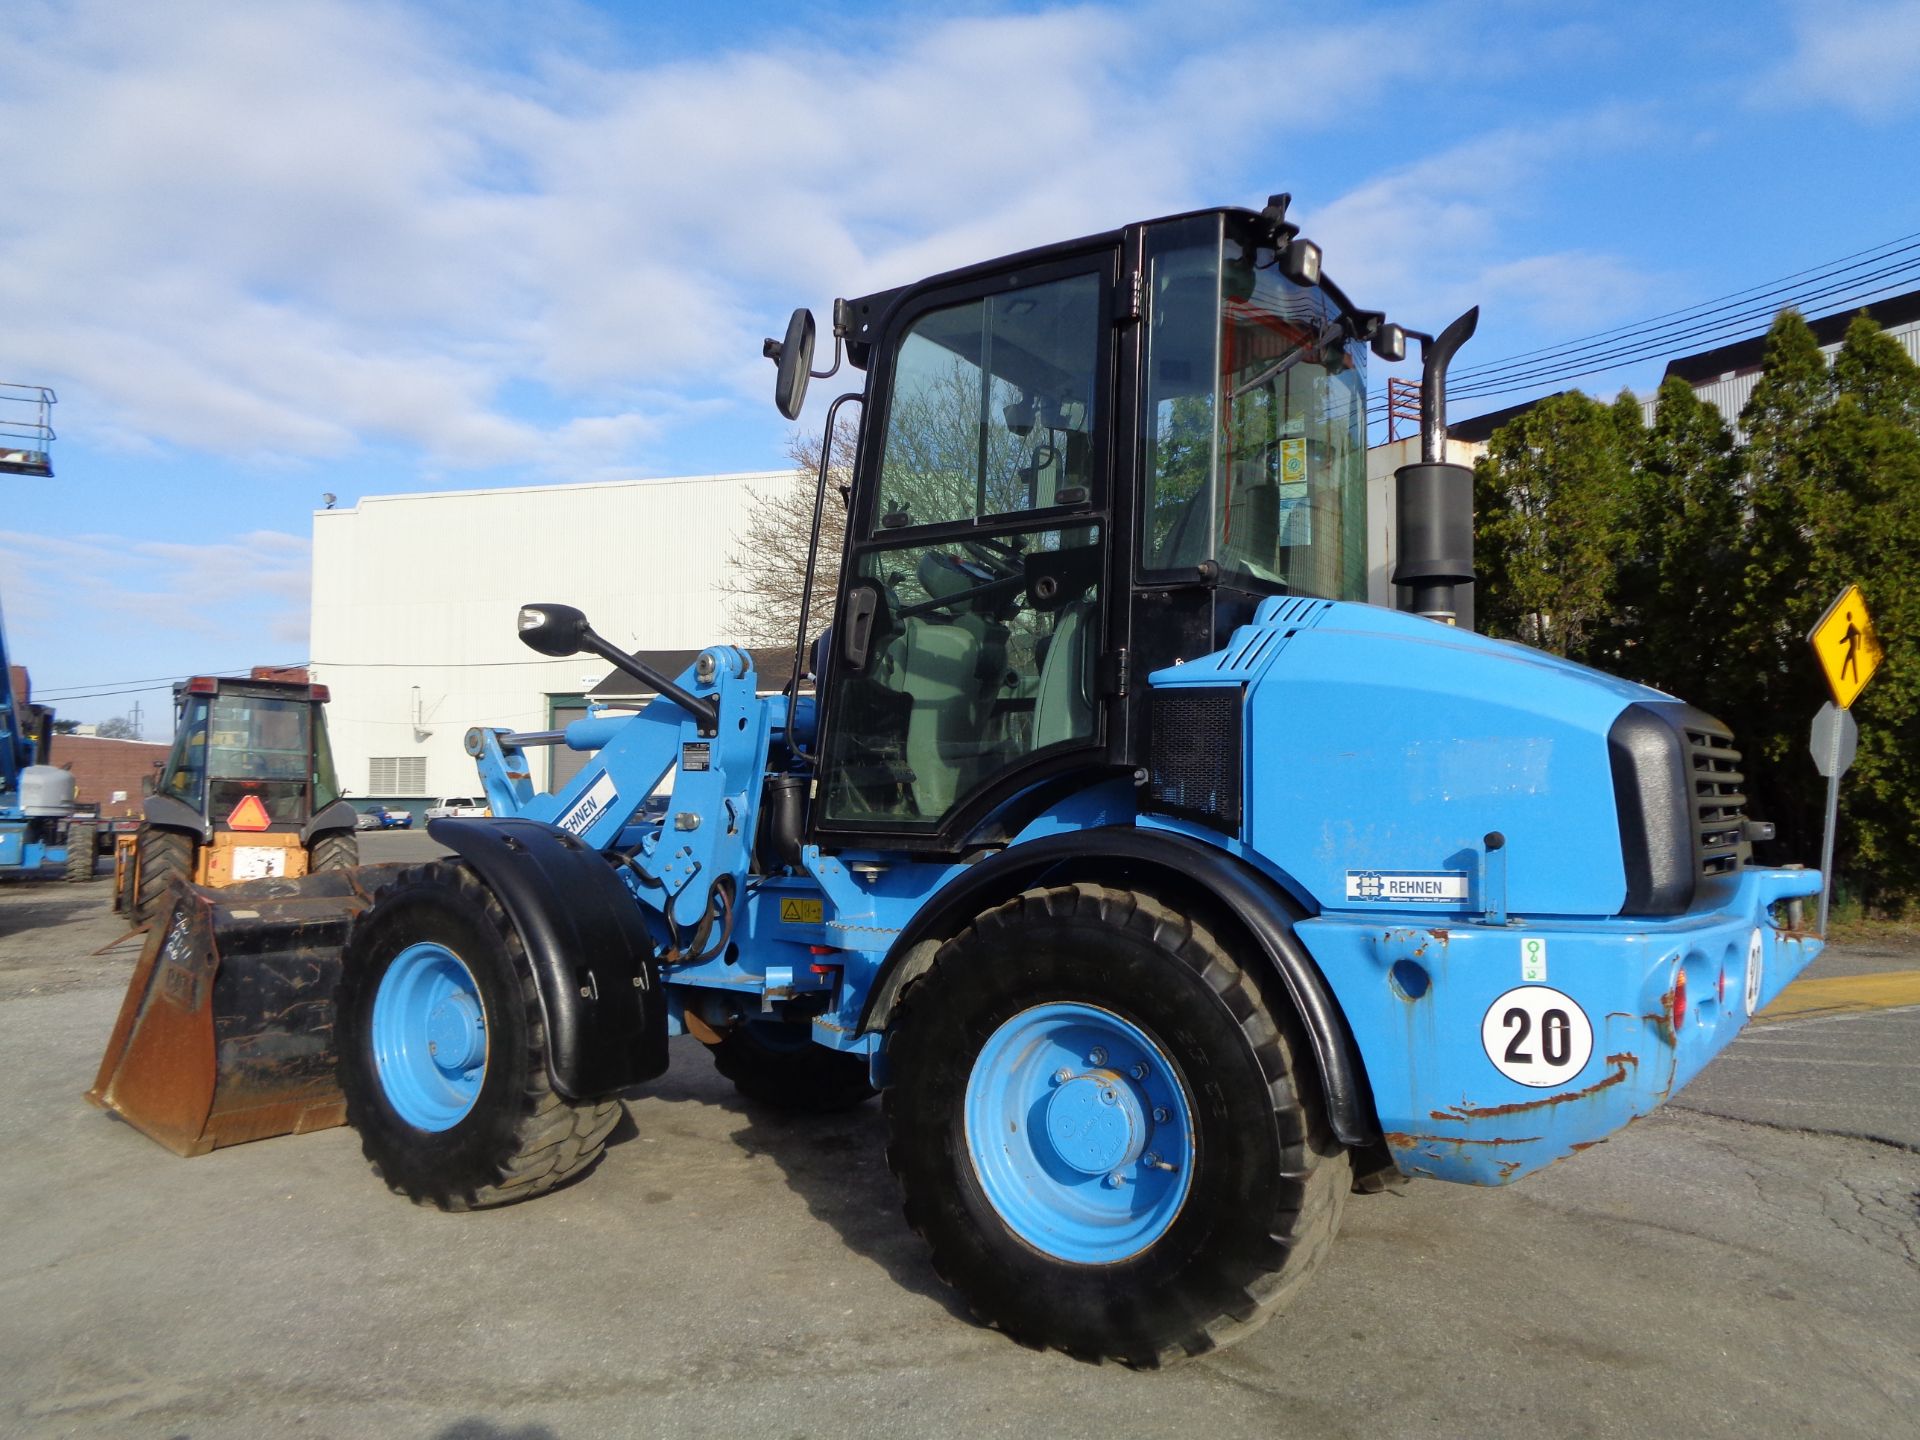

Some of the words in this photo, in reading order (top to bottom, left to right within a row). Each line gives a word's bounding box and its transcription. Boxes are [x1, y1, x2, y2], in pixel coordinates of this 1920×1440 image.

[563, 796, 598, 831] EHNEN
[1389, 880, 1443, 894] REHNEN
[1502, 1007, 1571, 1067] 20
